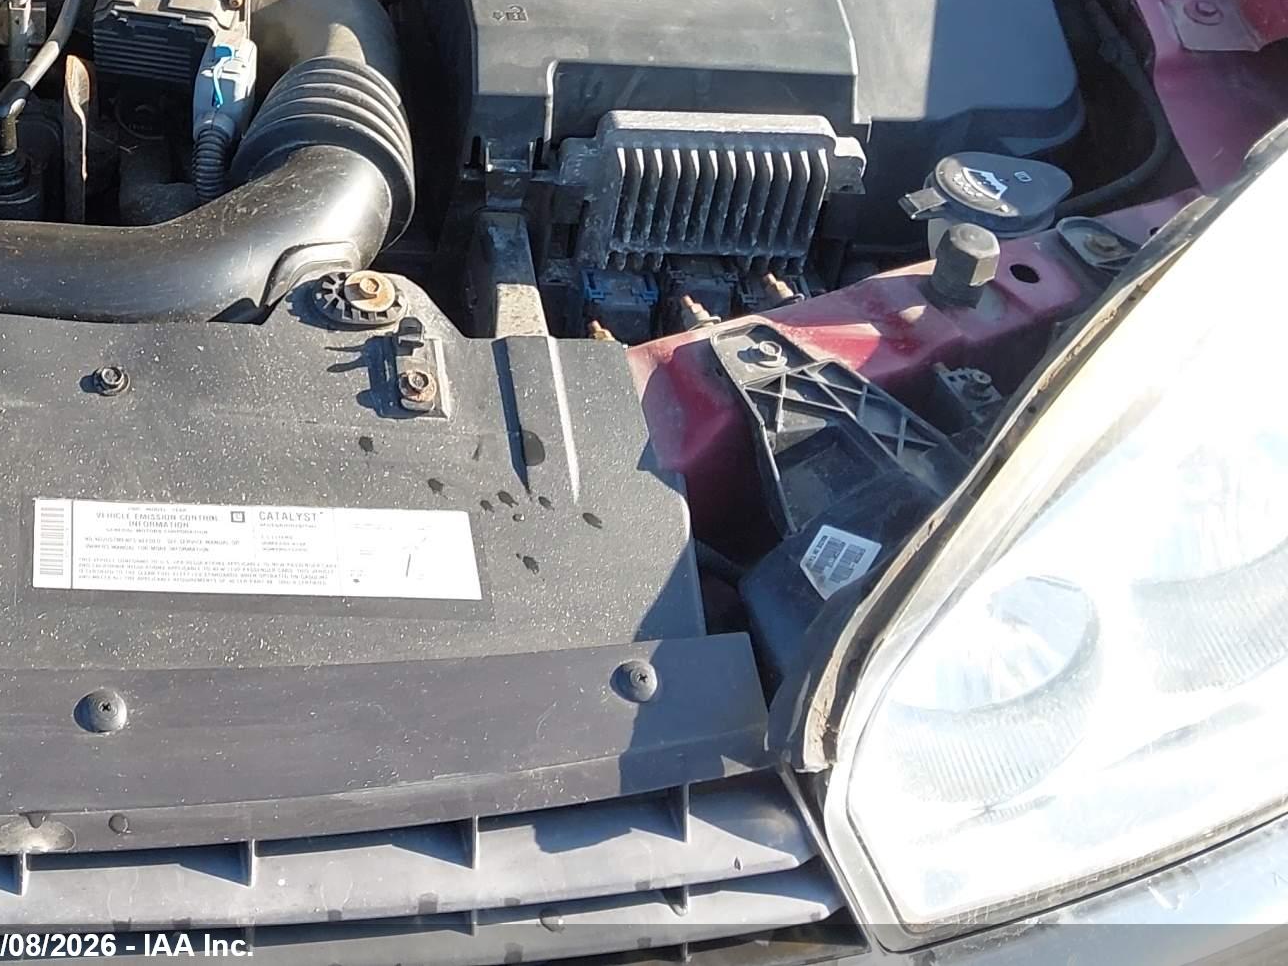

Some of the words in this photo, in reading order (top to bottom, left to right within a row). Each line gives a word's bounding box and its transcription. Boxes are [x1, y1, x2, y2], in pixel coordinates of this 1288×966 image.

[96, 512, 130, 520] VEHICLE
[135, 513, 176, 521] EMISSION
[179, 514, 218, 522] CONTROL
[259, 511, 317, 522] CATALYST
[129, 520, 189, 528] INFORMATION
